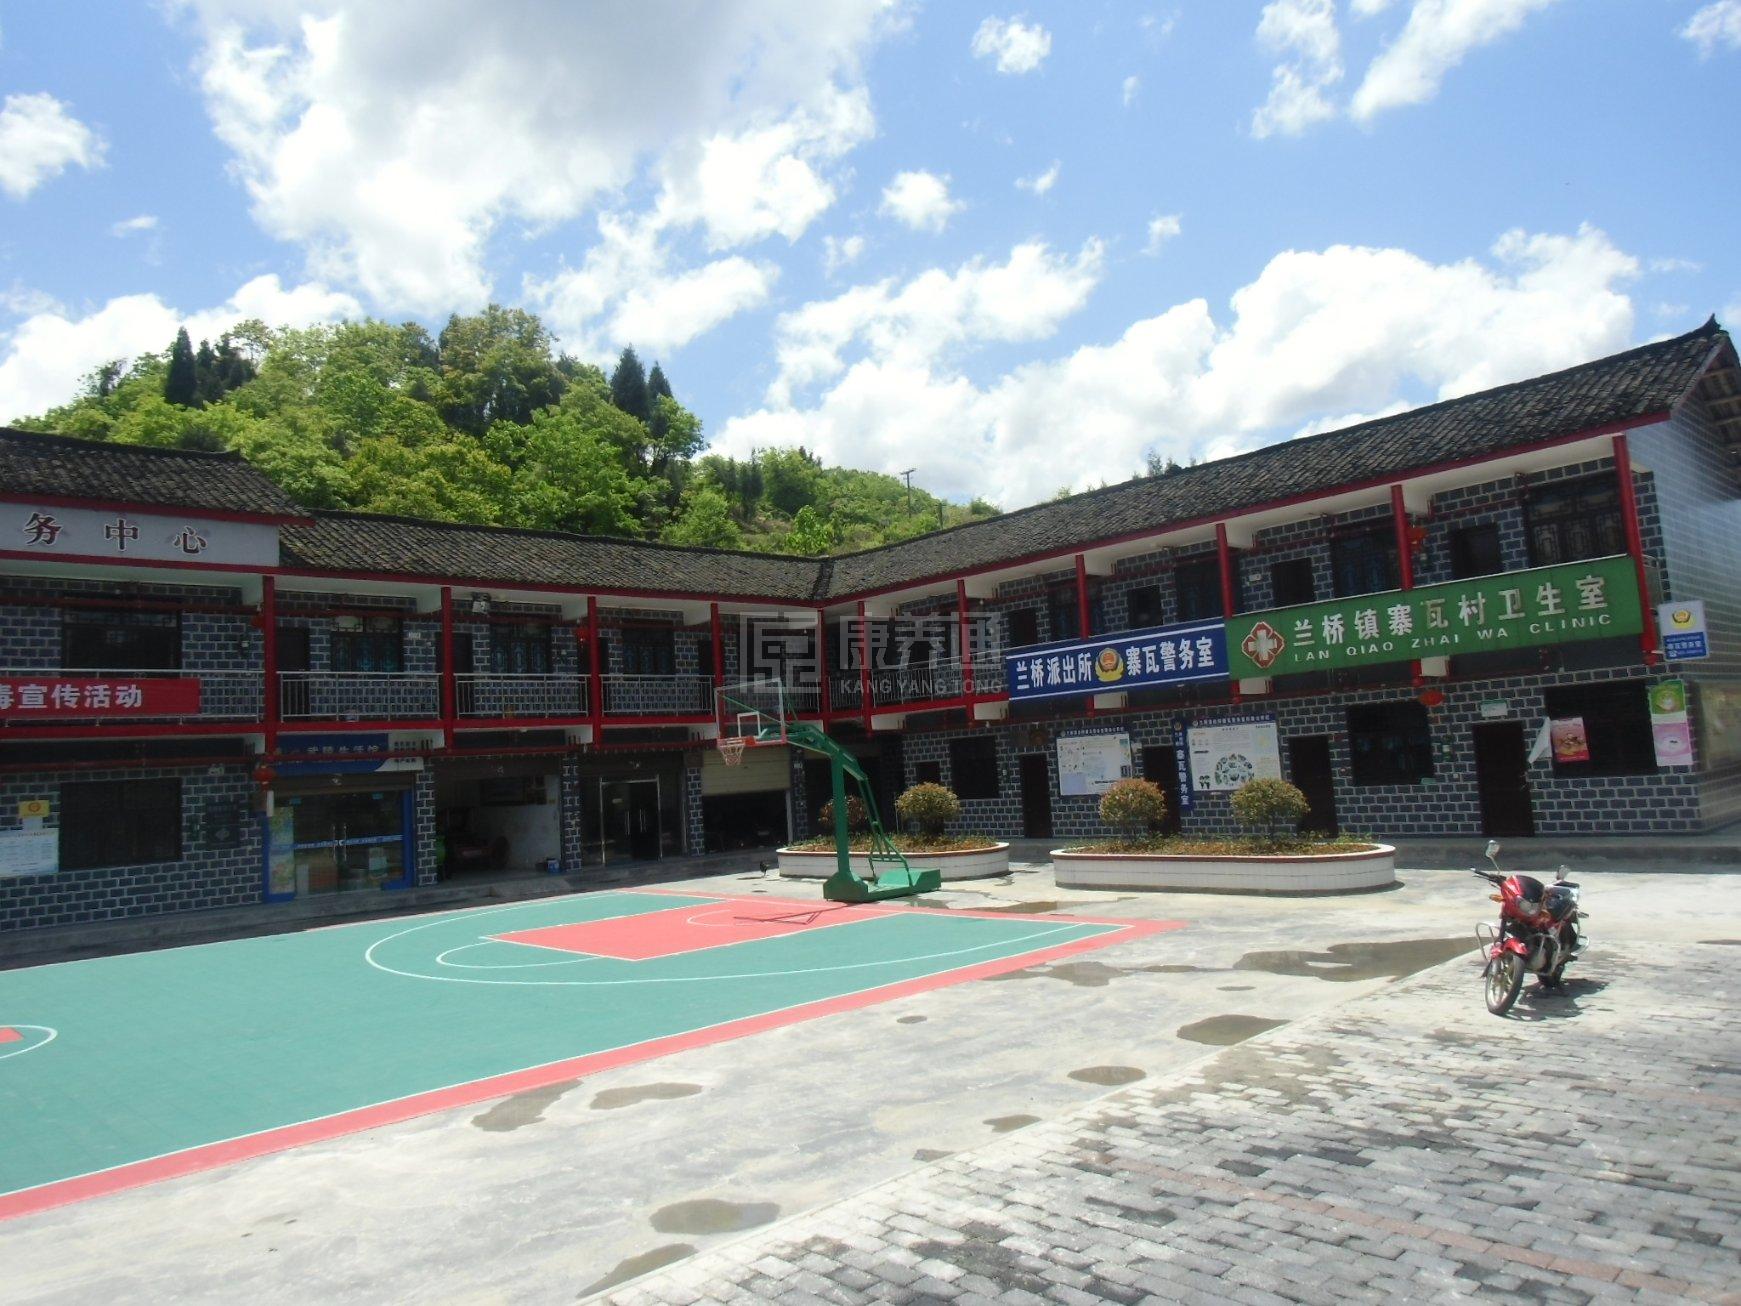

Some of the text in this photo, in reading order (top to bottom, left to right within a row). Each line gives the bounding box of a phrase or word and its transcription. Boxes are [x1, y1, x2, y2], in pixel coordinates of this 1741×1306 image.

[23, 512, 208, 554] 务中心
[1293, 575, 1609, 646] 兰桥镇寨瓦村卫生室
[1016, 636, 1215, 690] 兰桥派出所 寨瓦警务室
[1294, 614, 1613, 662] LAN QIAO ZHAI WA CLINIC
